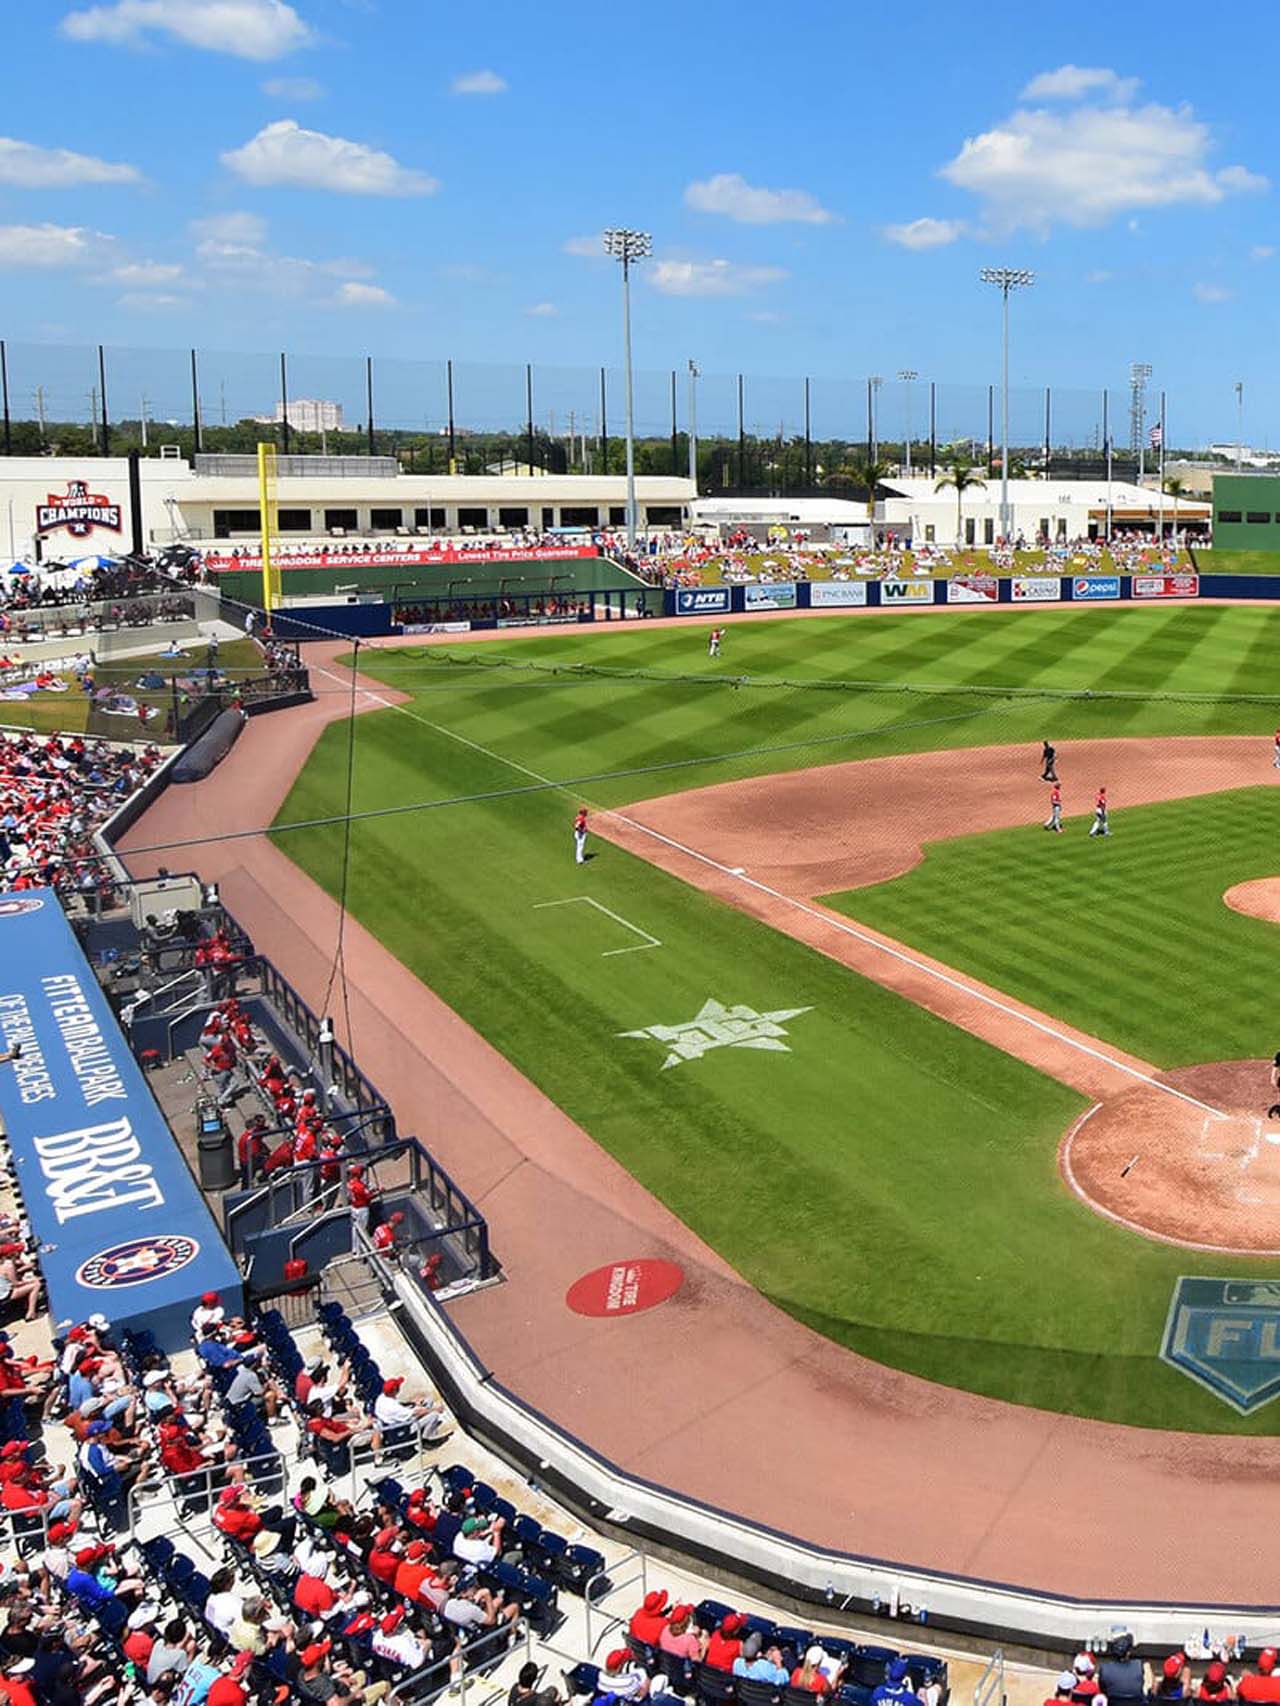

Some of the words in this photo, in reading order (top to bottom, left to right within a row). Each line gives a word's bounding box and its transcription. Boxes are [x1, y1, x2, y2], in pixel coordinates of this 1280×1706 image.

[40, 506, 118, 526] CHAMPIONS
[326, 555, 372, 565] SERVICE
[373, 552, 420, 563] CENTERS
[458, 551, 490, 561] Lowest
[512, 548, 533, 559] Price
[536, 546, 579, 558] Guarantee
[1089, 582, 1116, 594] pepsi
[33, 1115, 165, 1225] BB&T
